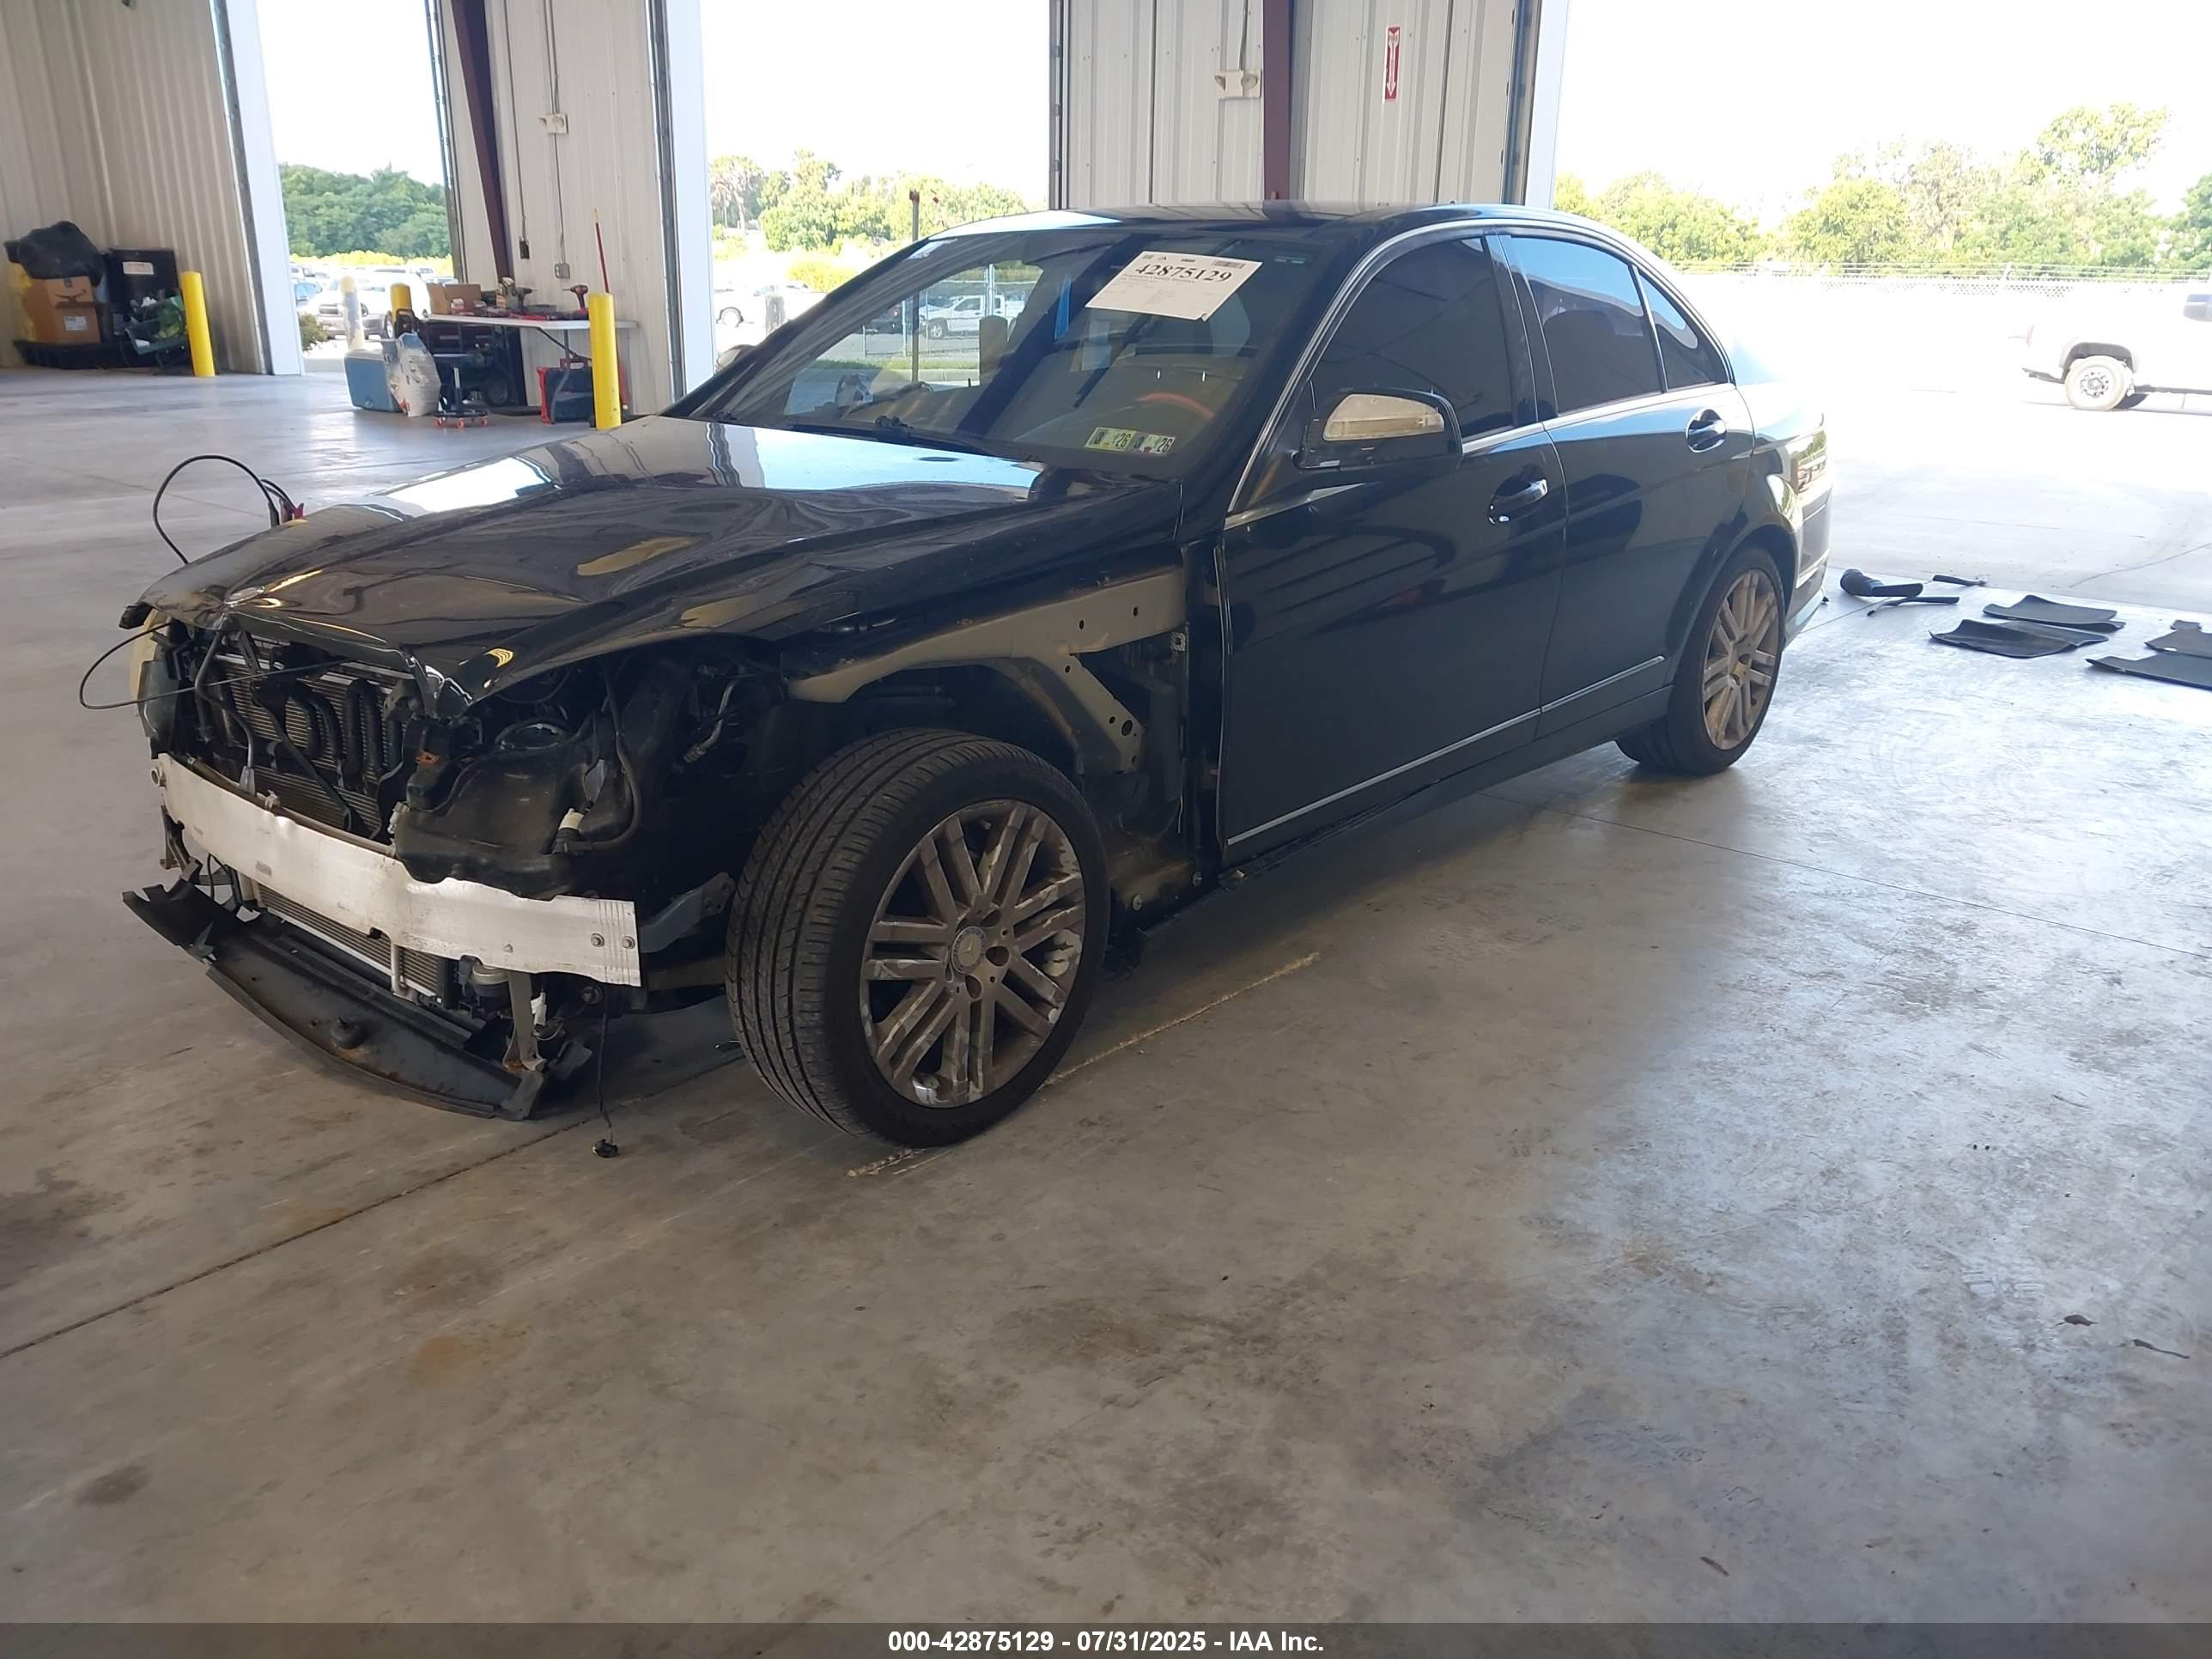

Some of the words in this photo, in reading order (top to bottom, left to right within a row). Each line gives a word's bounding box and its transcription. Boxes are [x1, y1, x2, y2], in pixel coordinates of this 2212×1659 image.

[1135, 264, 1232, 283] 42875129
[1115, 432, 1132, 447] 26
[1156, 437, 1173, 453] 26
